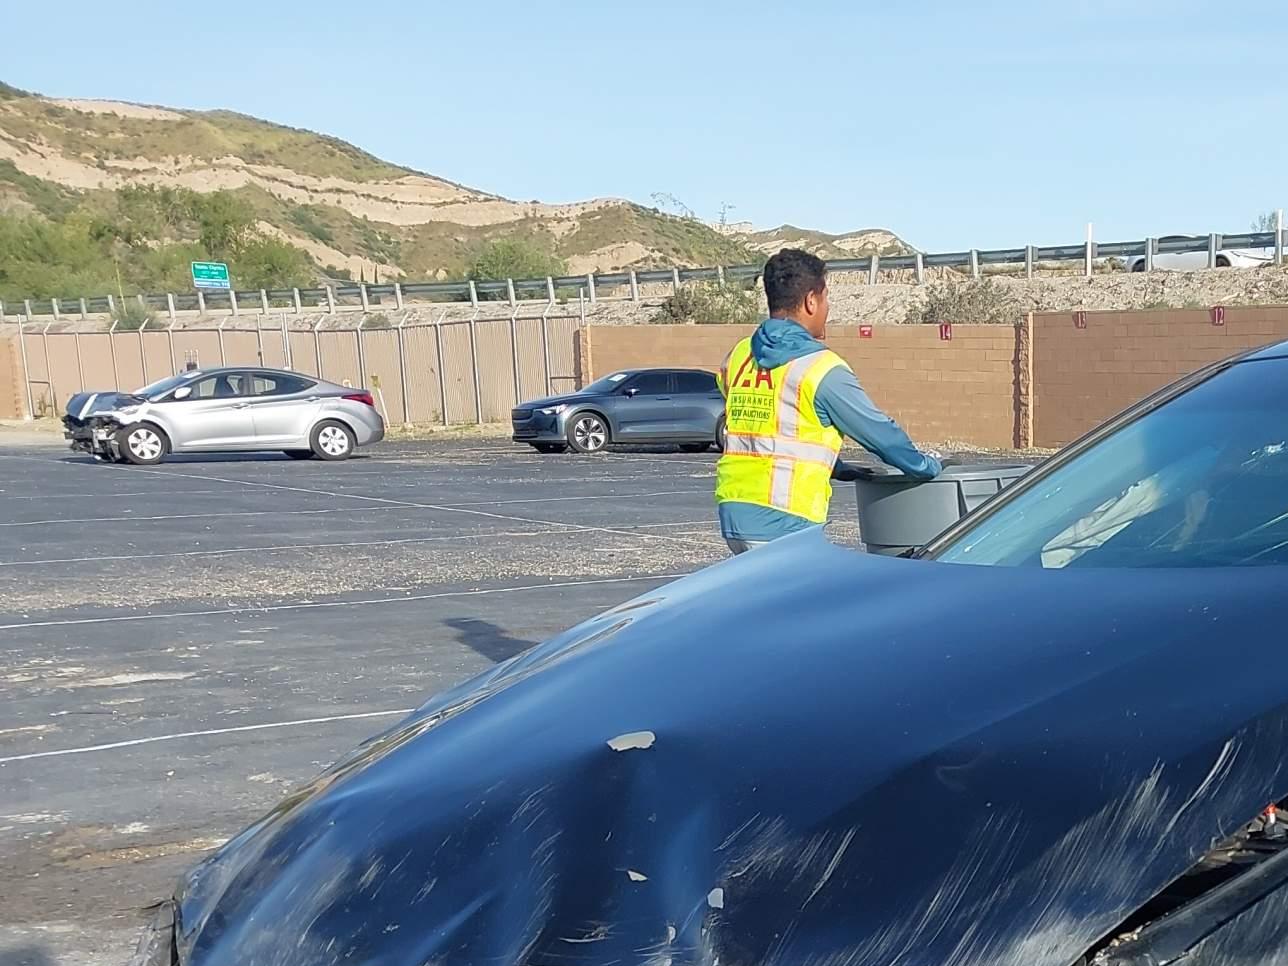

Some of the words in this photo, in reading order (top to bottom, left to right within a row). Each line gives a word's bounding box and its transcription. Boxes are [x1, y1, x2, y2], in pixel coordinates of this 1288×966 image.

[1078, 311, 1087, 328] 13
[1215, 307, 1225, 324] 12
[941, 324, 951, 340] 14
[731, 395, 773, 407] INSURANCE
